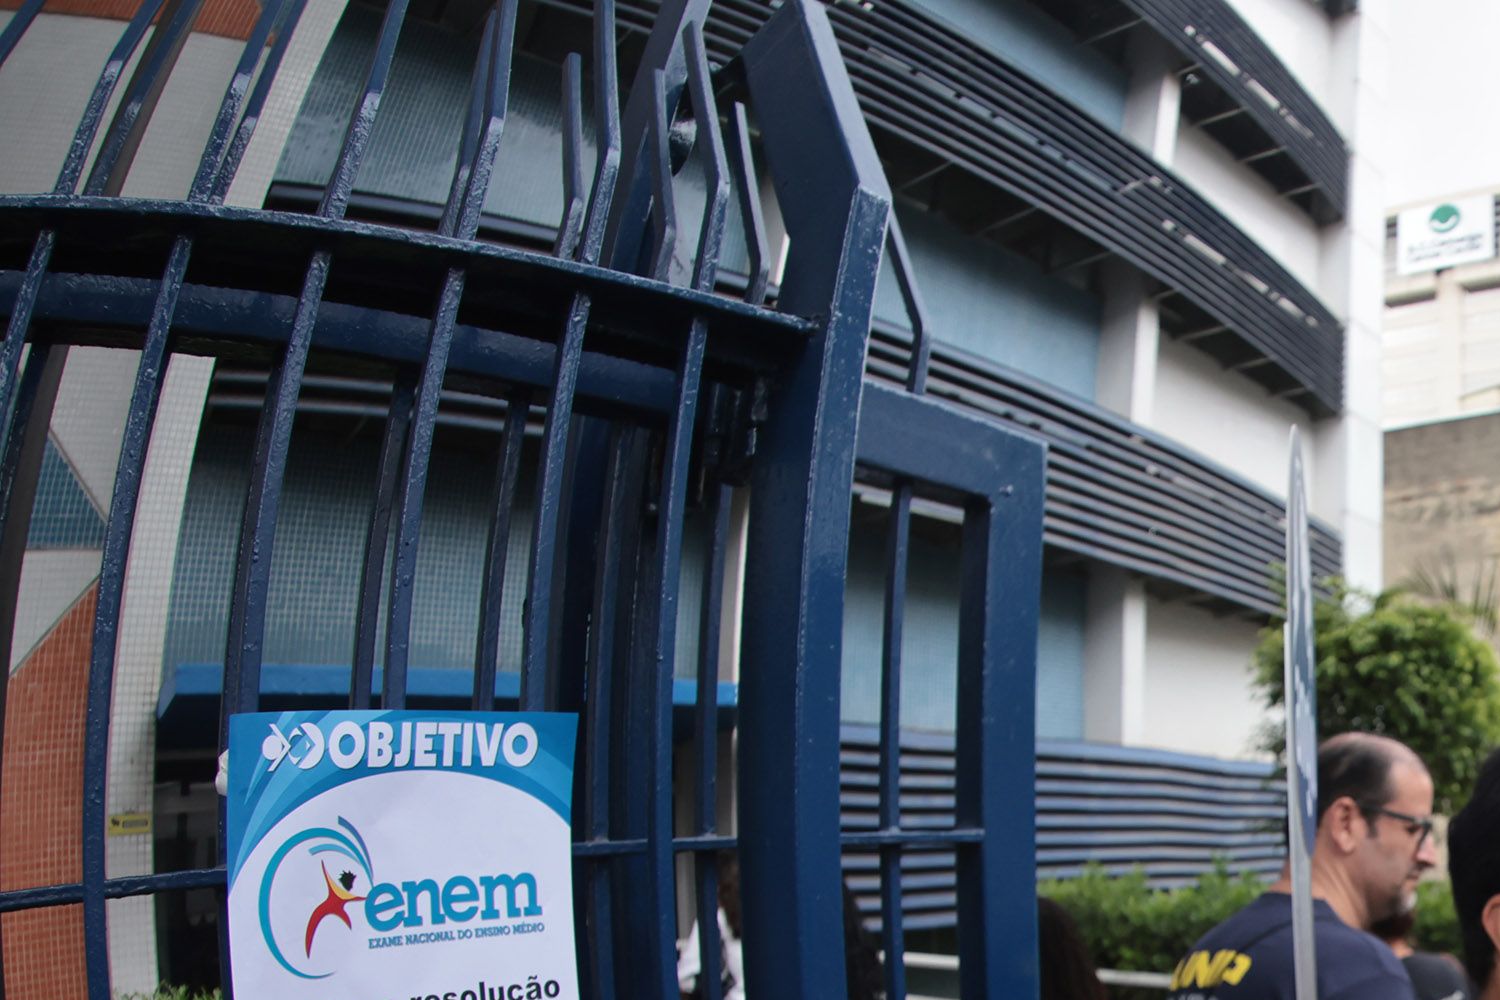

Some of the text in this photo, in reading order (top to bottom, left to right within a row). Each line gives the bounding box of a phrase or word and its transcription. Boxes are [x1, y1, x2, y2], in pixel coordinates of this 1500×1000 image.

[329, 721, 539, 769] OBJETIVO
[365, 872, 542, 932] enem
[368, 922, 545, 949] EXAME NACIONAL DO ENSINO MÉDIO
